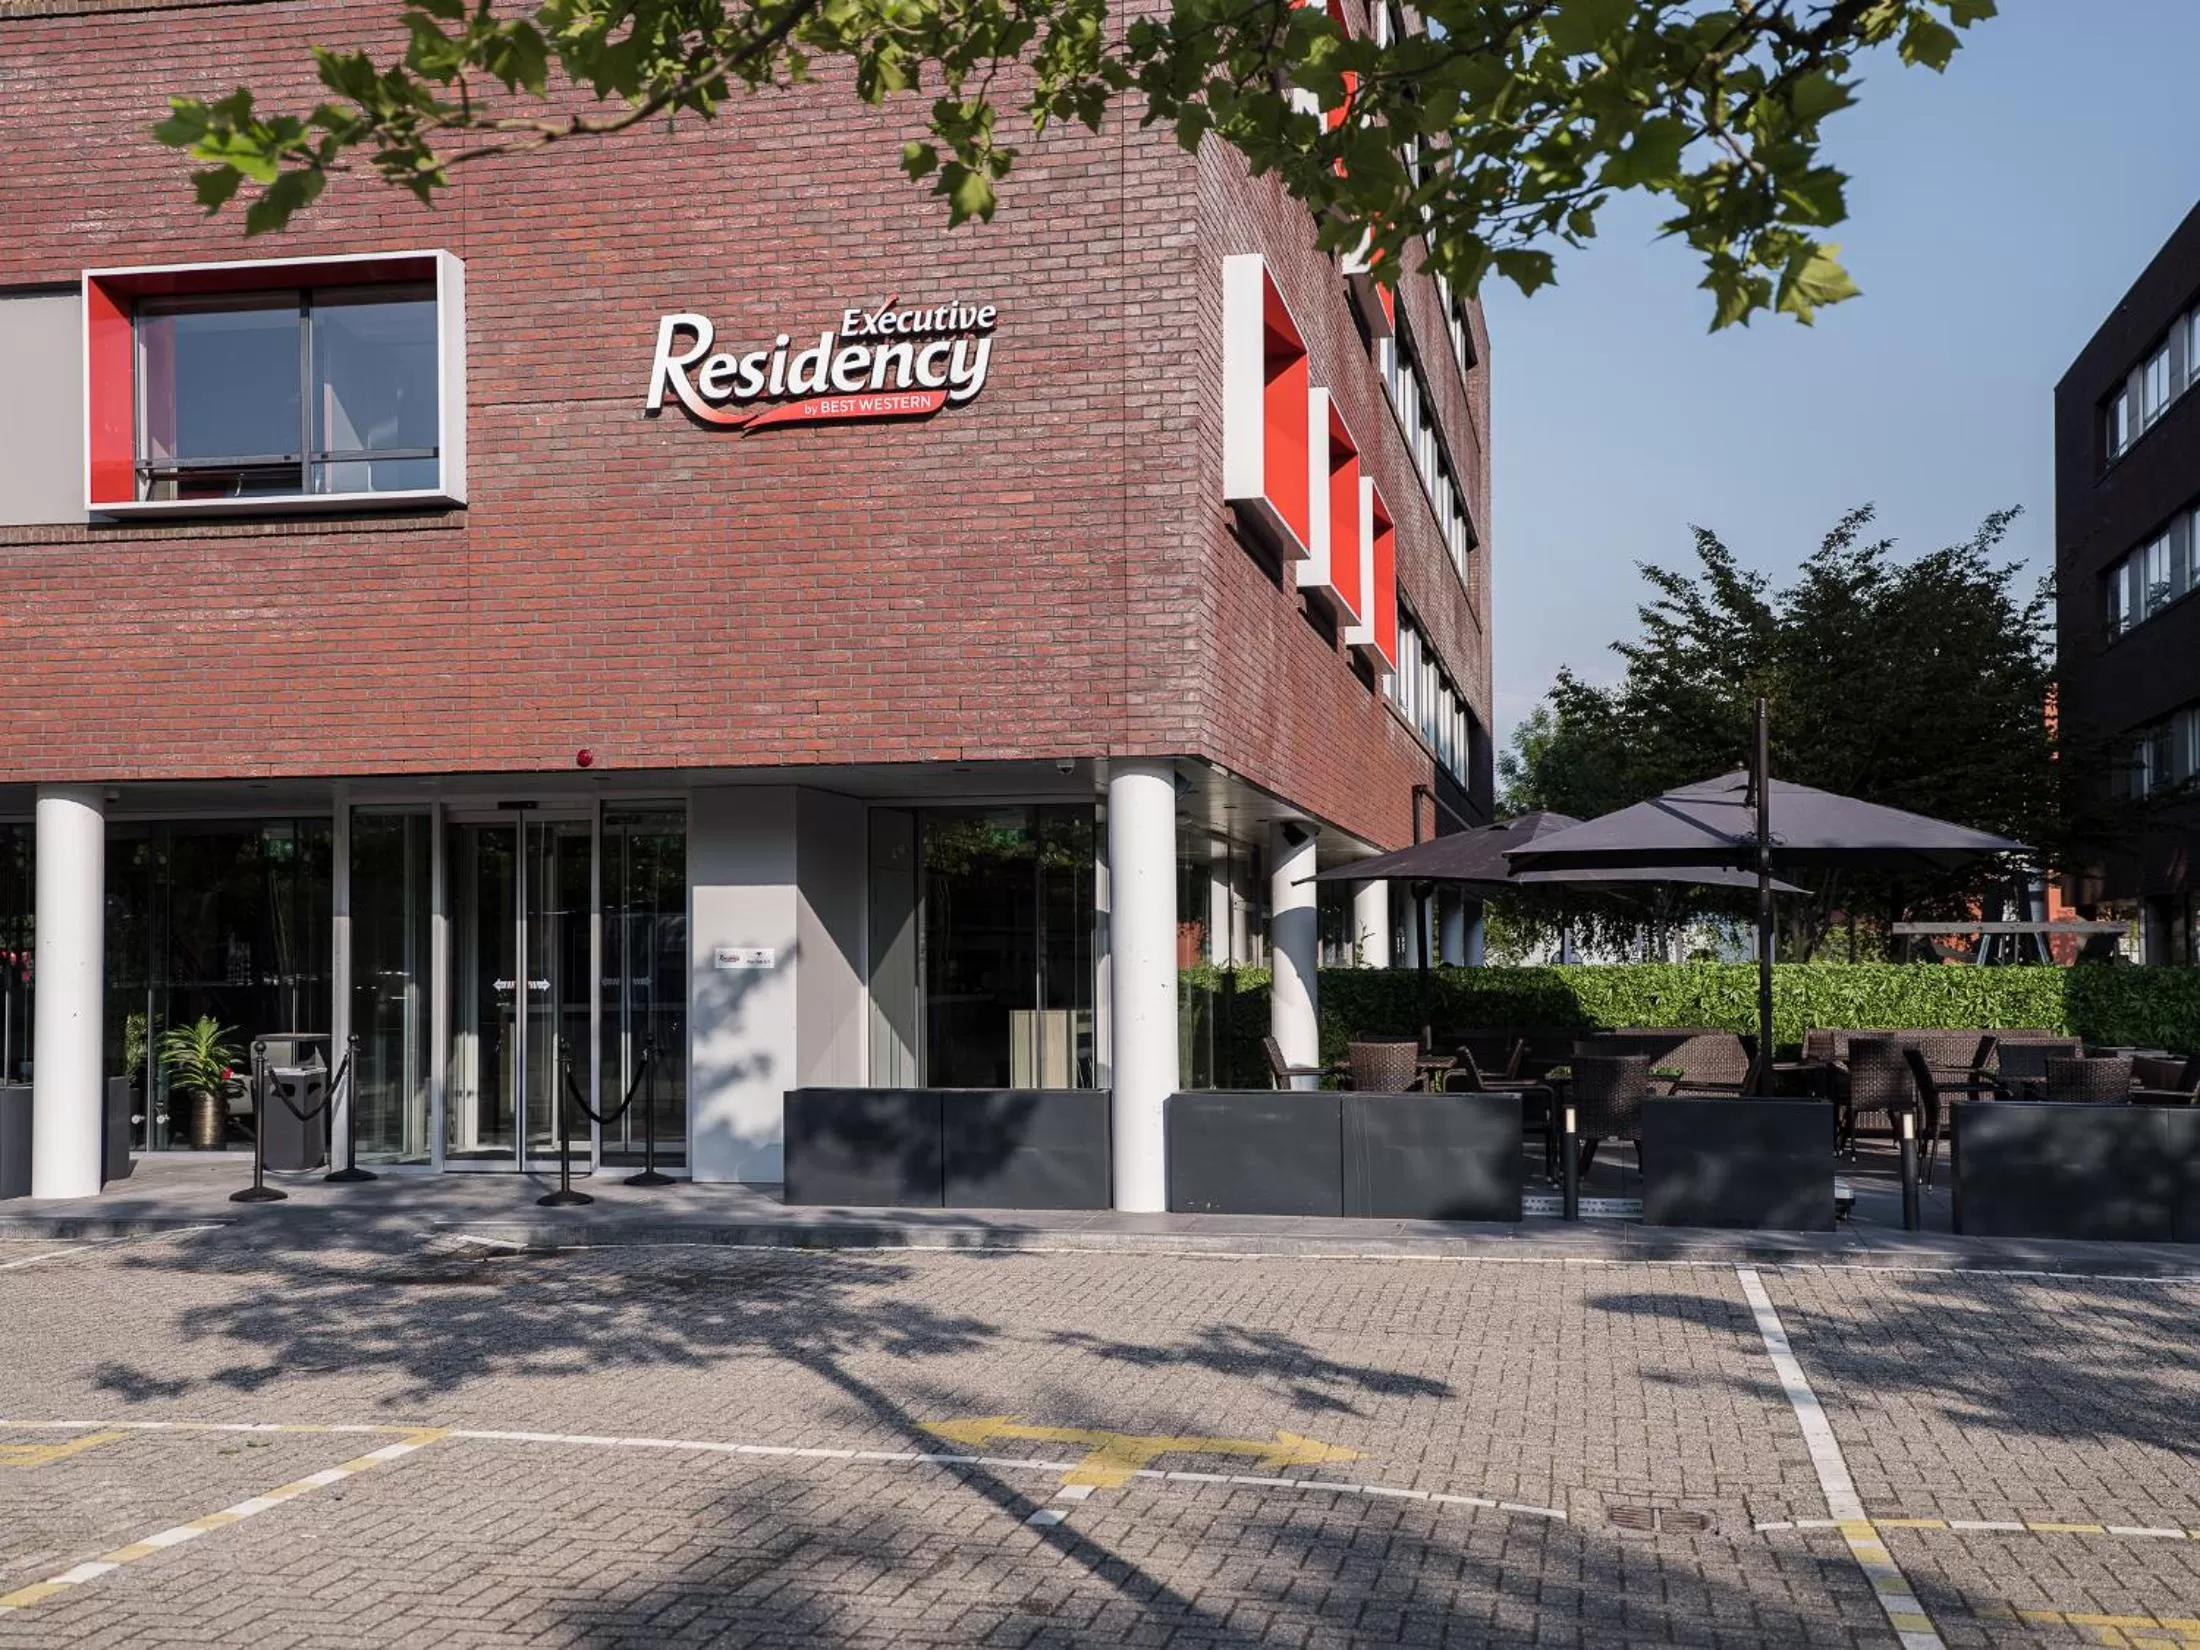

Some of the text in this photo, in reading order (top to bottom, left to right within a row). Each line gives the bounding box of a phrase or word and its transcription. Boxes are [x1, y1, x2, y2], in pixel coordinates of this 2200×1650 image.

[841, 294, 997, 338] Executive
[646, 312, 994, 409] Residency
[804, 396, 931, 416] by BEST WESTERN
